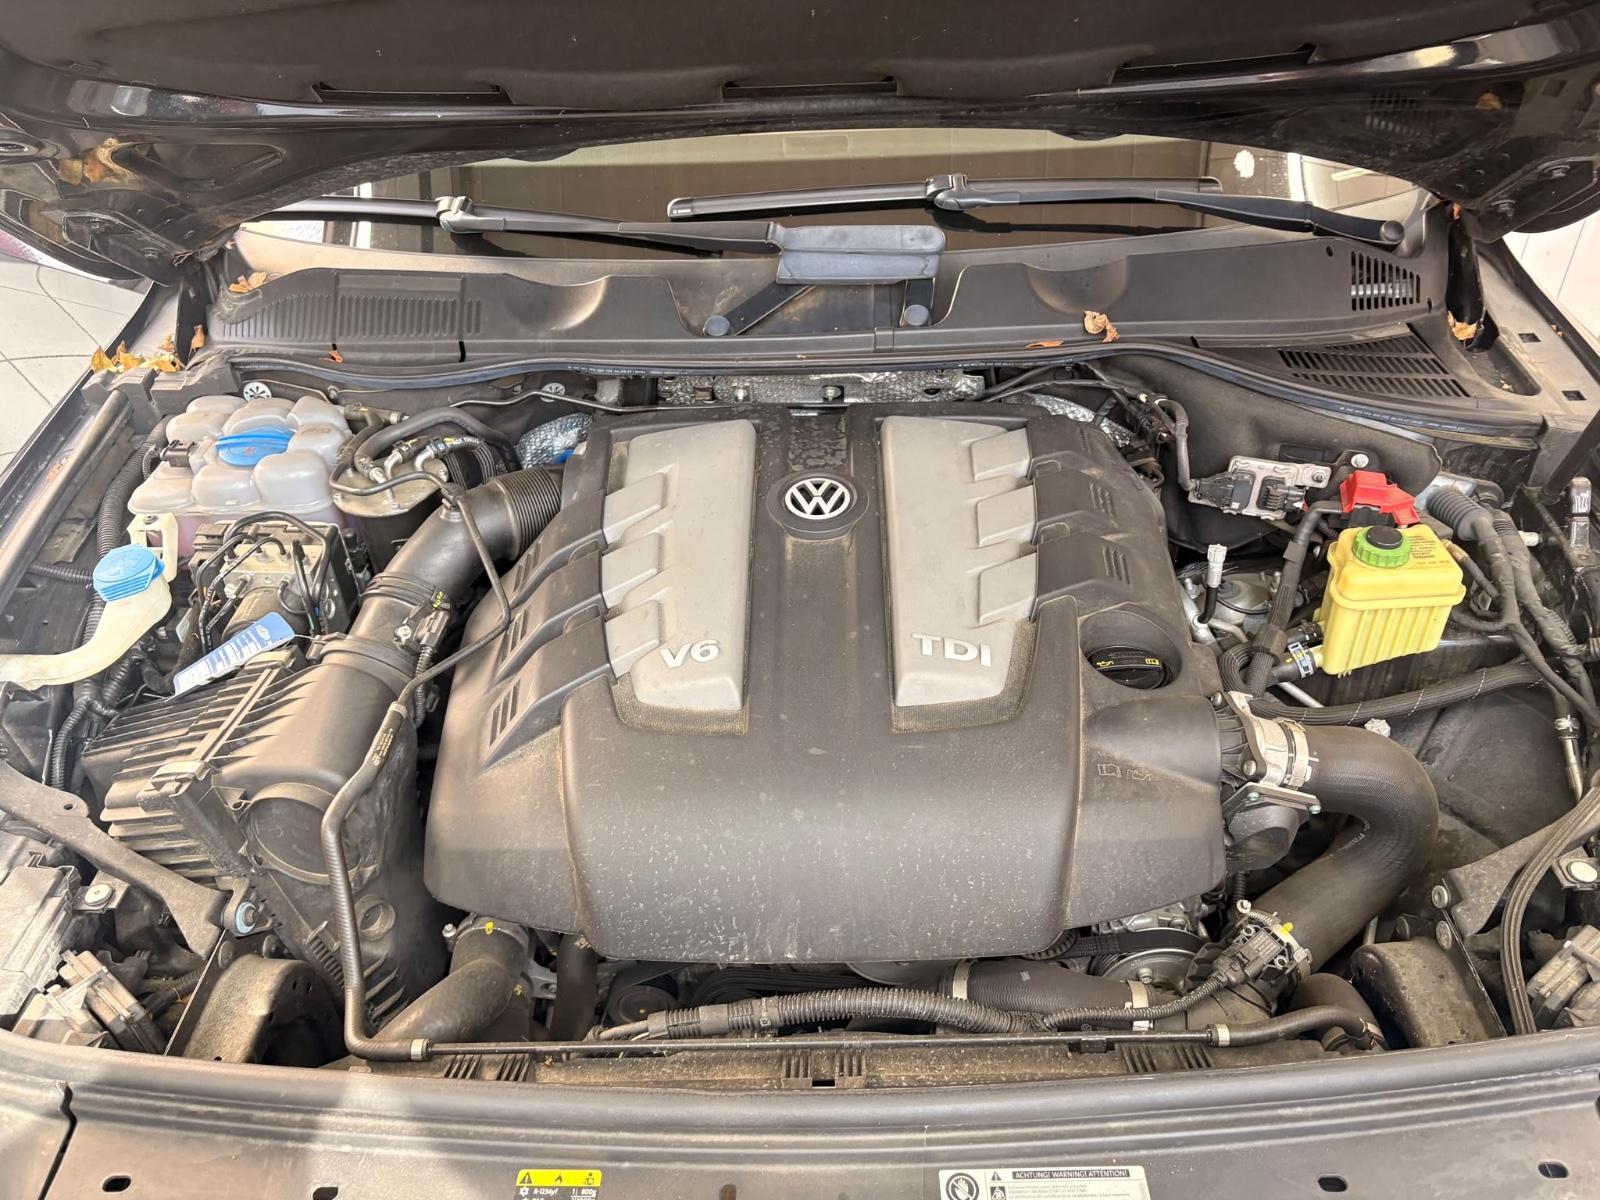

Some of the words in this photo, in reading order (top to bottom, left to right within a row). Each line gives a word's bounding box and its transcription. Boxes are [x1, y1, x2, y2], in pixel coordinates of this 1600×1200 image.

[785, 477, 850, 520] VW
[659, 639, 719, 668] V6
[911, 633, 991, 667] TDI
[1015, 1171, 1050, 1179] ACHTUNG!
[1052, 1170, 1087, 1178] WARNING!
[1088, 1169, 1128, 1177] ATTENTION!
